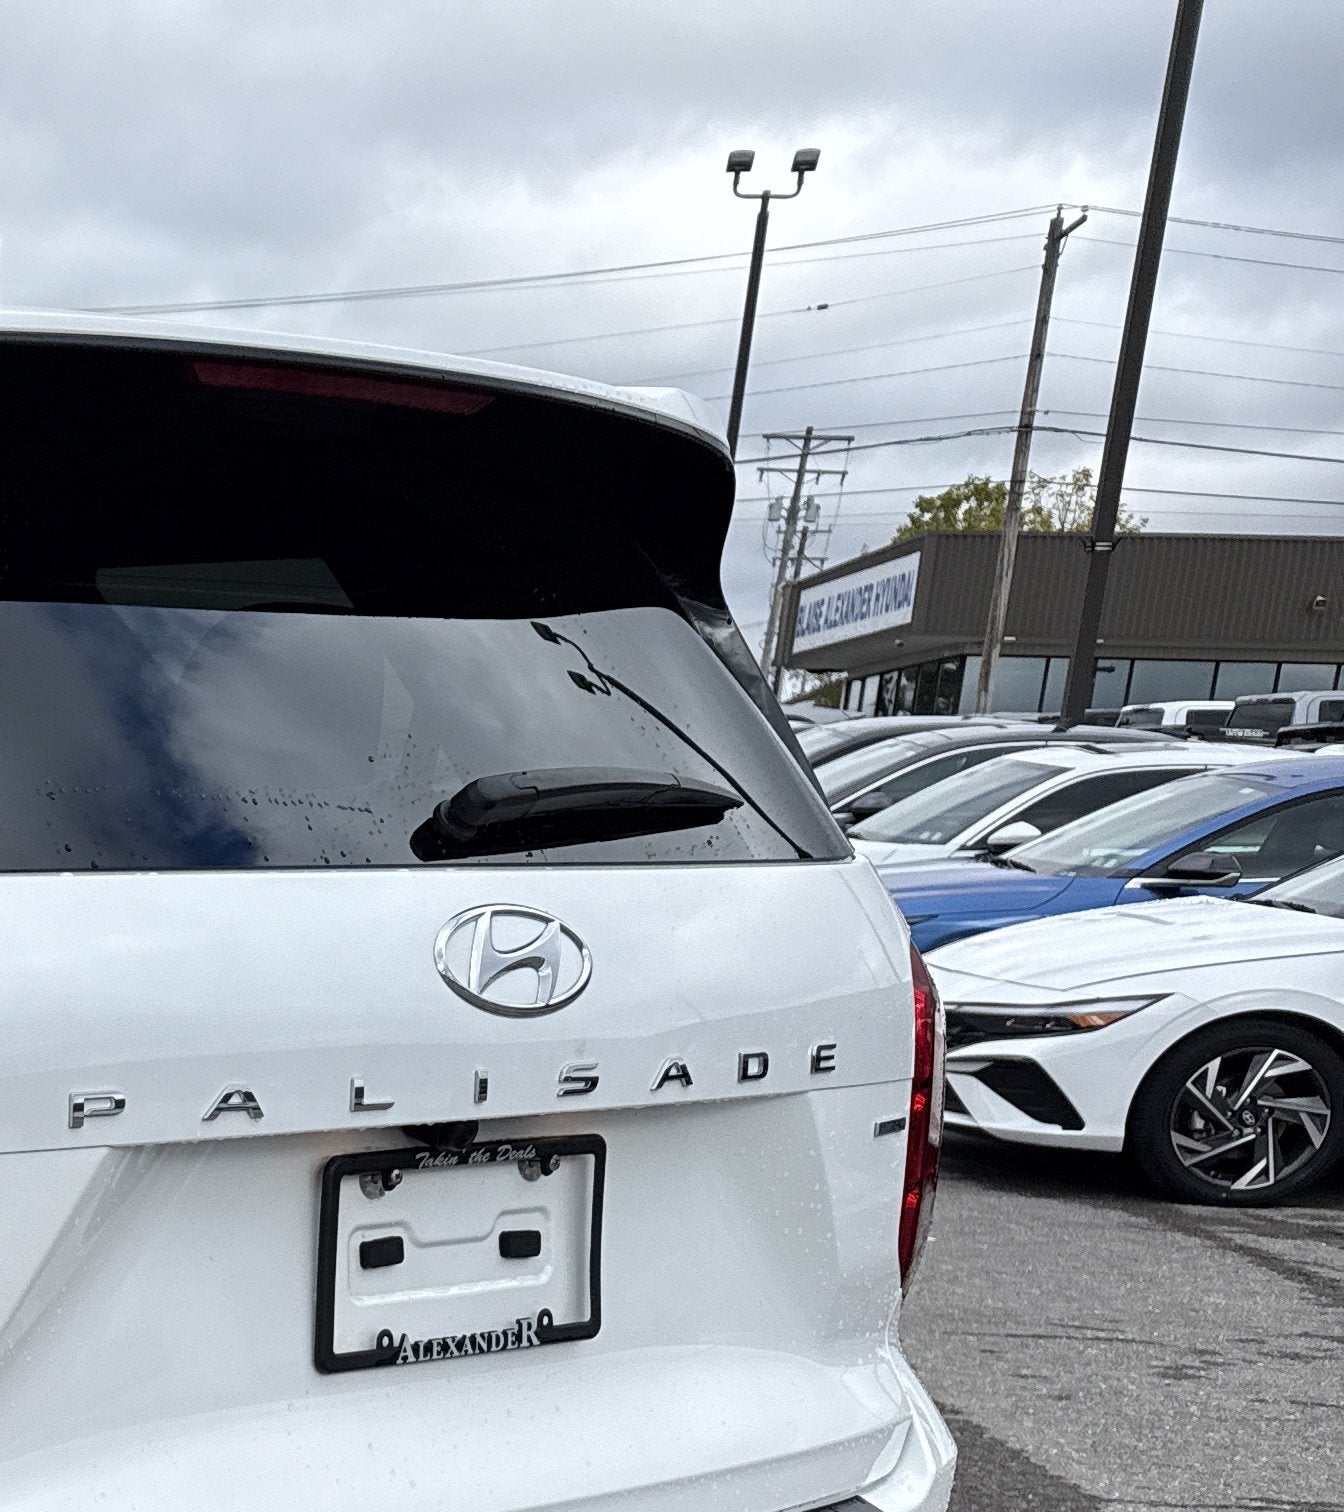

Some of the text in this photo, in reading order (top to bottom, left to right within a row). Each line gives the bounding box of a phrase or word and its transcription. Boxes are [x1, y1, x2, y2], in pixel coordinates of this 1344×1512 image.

[823, 583, 874, 630] ALEXANDER
[872, 569, 916, 617] HYUNDAI
[67, 1043, 837, 1130] PALISADE
[415, 1144, 537, 1170] Takin' the Deals
[396, 1317, 540, 1364] ALEXANDER
